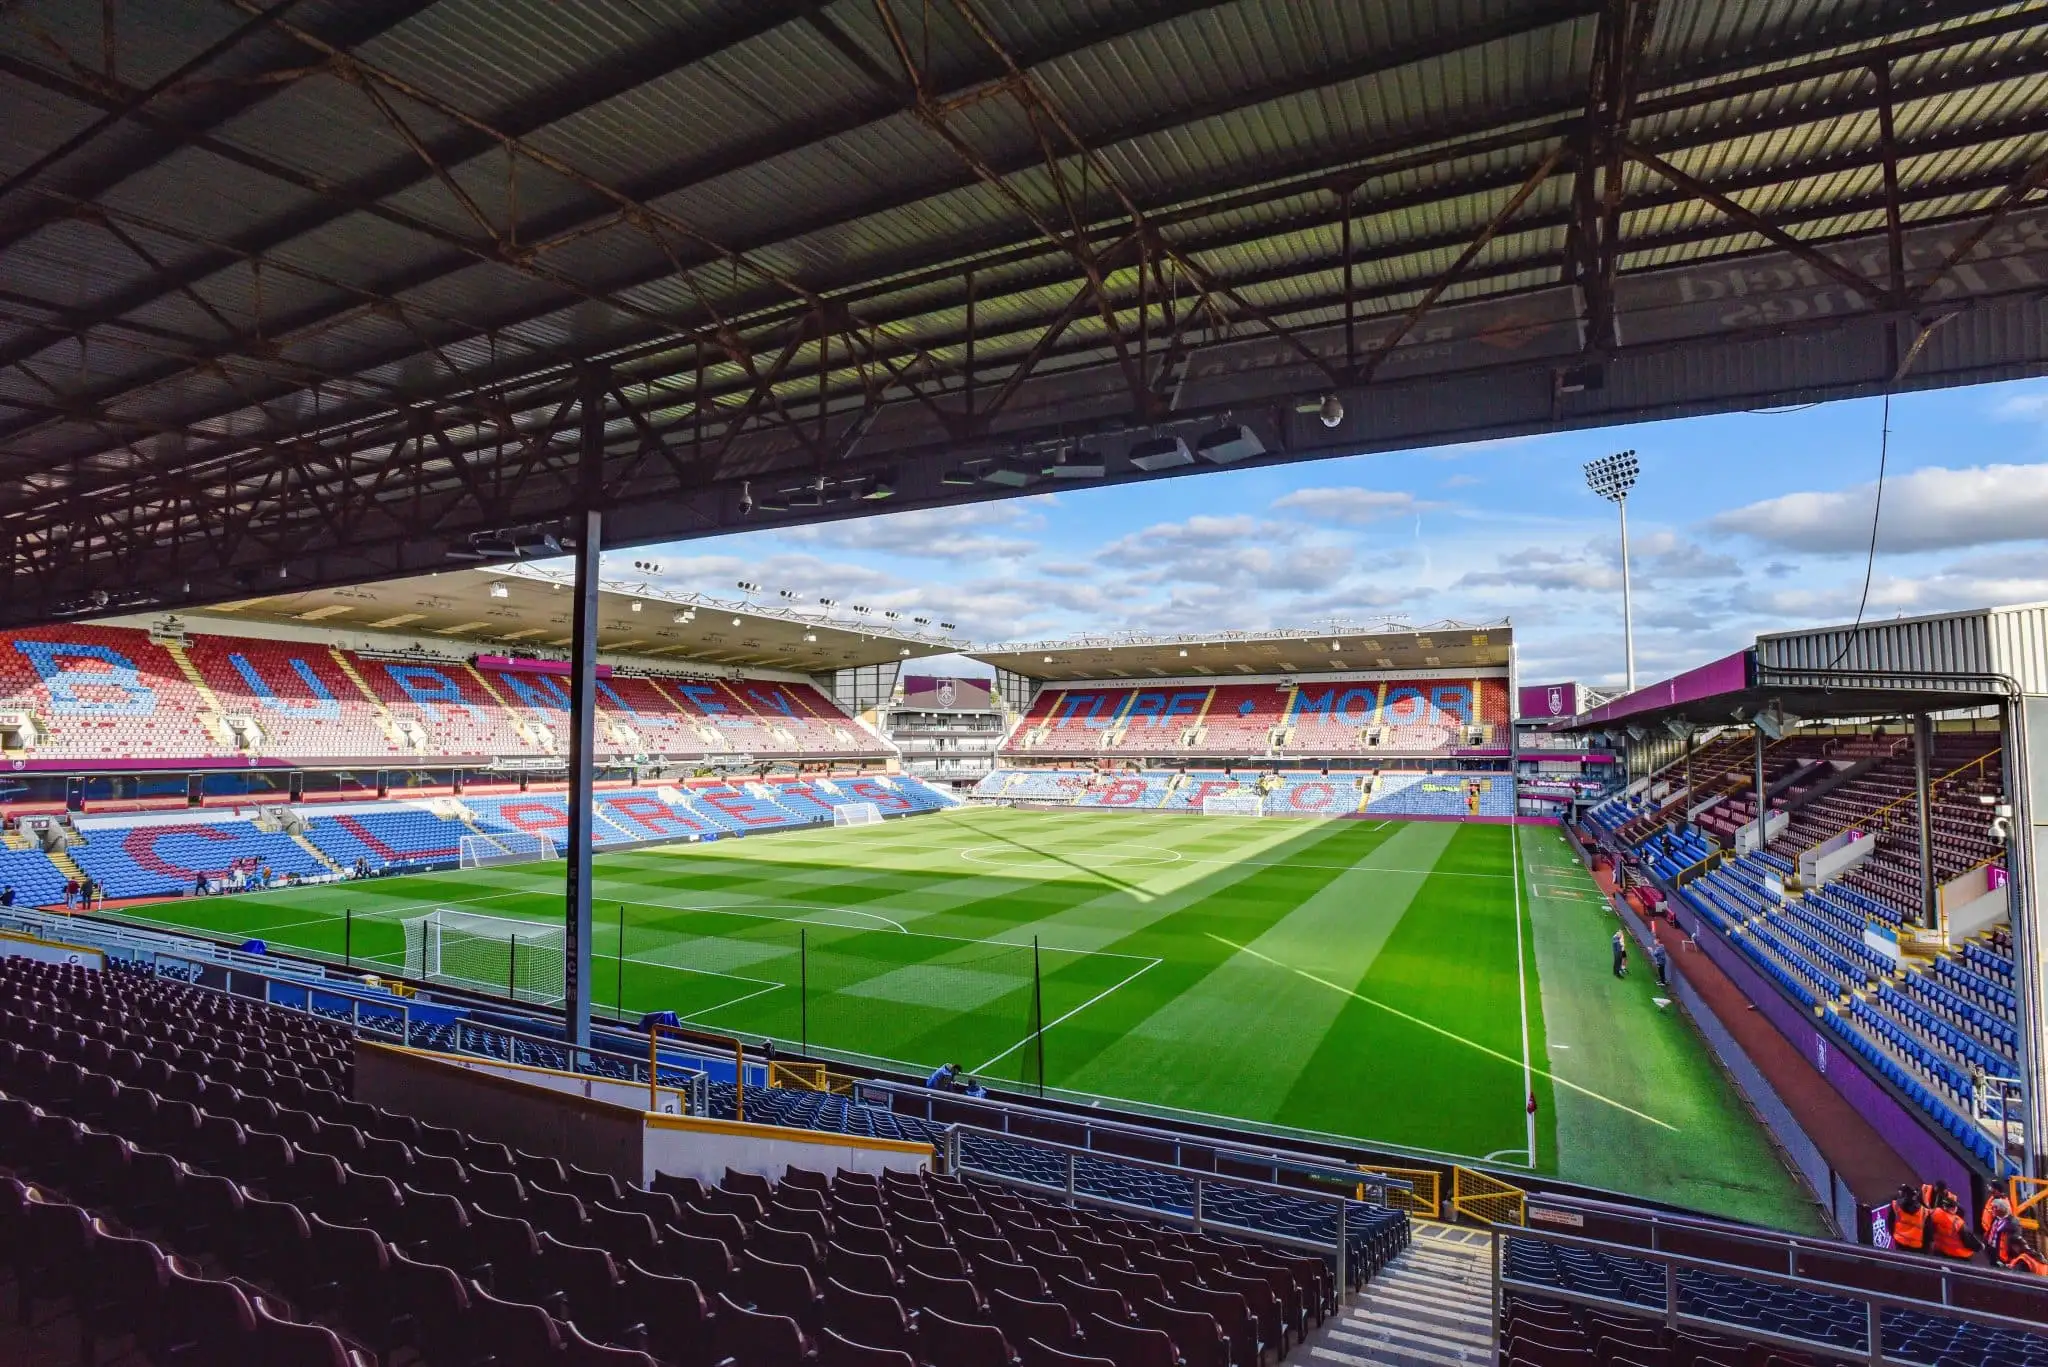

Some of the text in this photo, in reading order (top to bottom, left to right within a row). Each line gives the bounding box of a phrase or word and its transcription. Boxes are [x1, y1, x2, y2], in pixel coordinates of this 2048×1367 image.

[13, 640, 809, 729] BURNLEY
[1056, 687, 1474, 729] TURF MOOR
[123, 783, 911, 880] CLARETS
[69, 955, 78, 964] C
